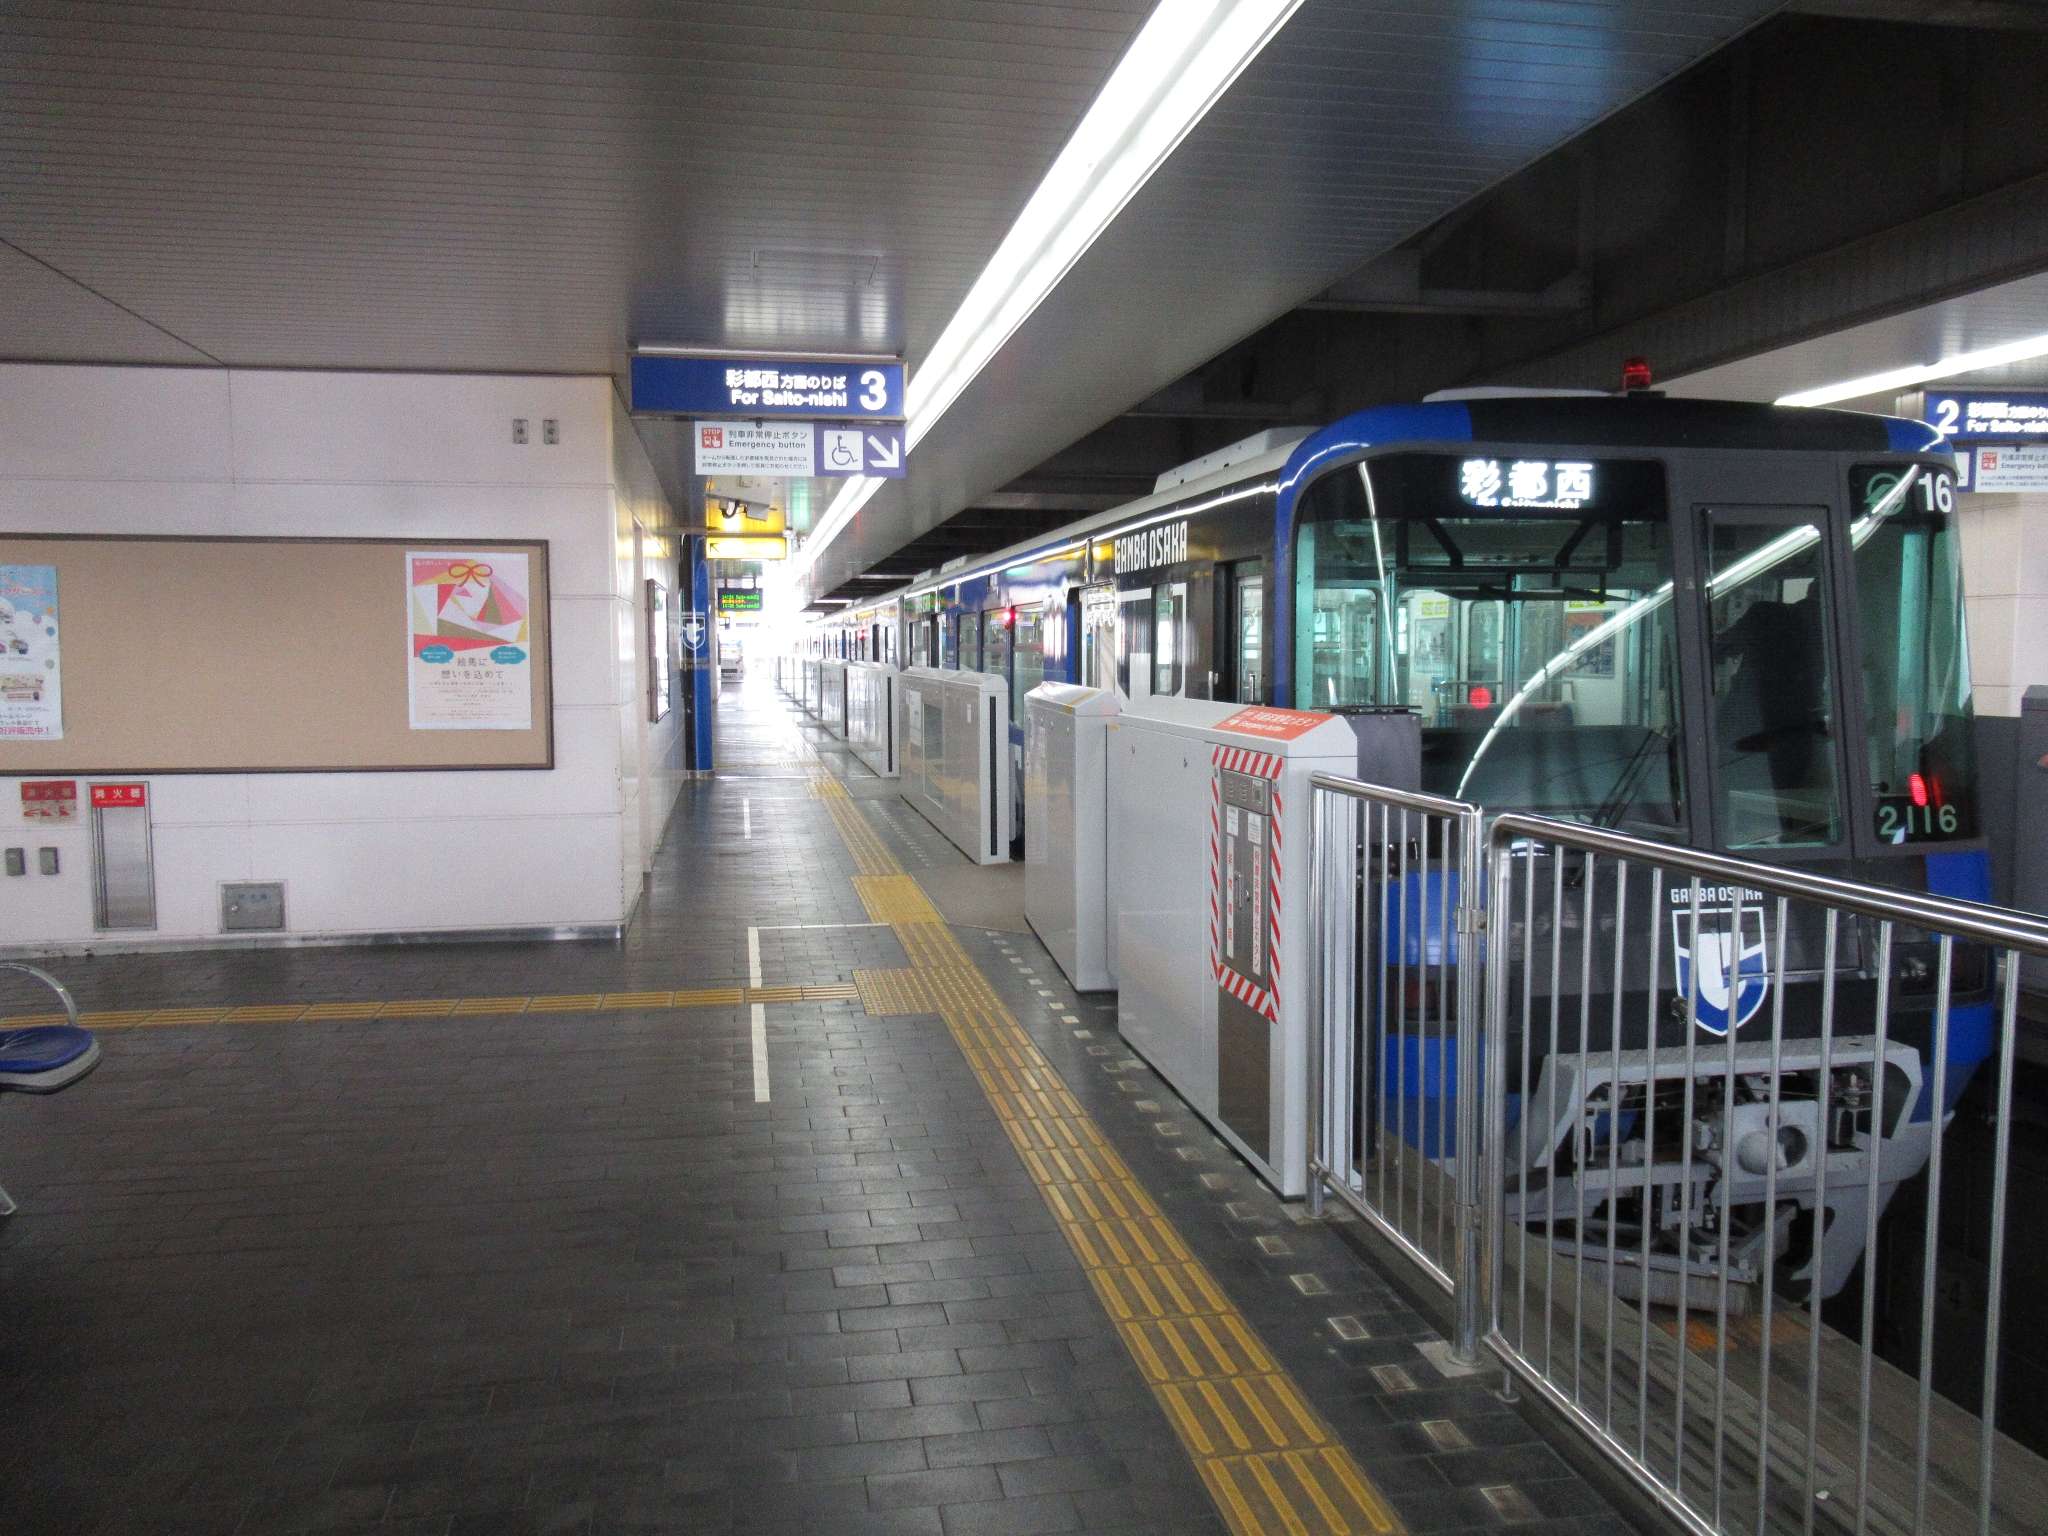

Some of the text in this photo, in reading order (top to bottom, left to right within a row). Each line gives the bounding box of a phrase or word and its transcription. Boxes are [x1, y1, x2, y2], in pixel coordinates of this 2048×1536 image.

[731, 389, 847, 407] For Saito-nishi
[860, 370, 887, 410] 3
[1937, 399, 1960, 434] 2
[729, 430, 808, 440] 列車非常停止ボタン
[729, 440, 806, 450] Emergency button
[1461, 459, 1593, 500] 彩都西
[1918, 472, 1953, 514] 16
[1114, 520, 1188, 574] GAMBA OSAKA
[95, 788, 140, 799] 消火器
[1879, 804, 1957, 835] 2116
[1671, 886, 1716, 903] GABA
